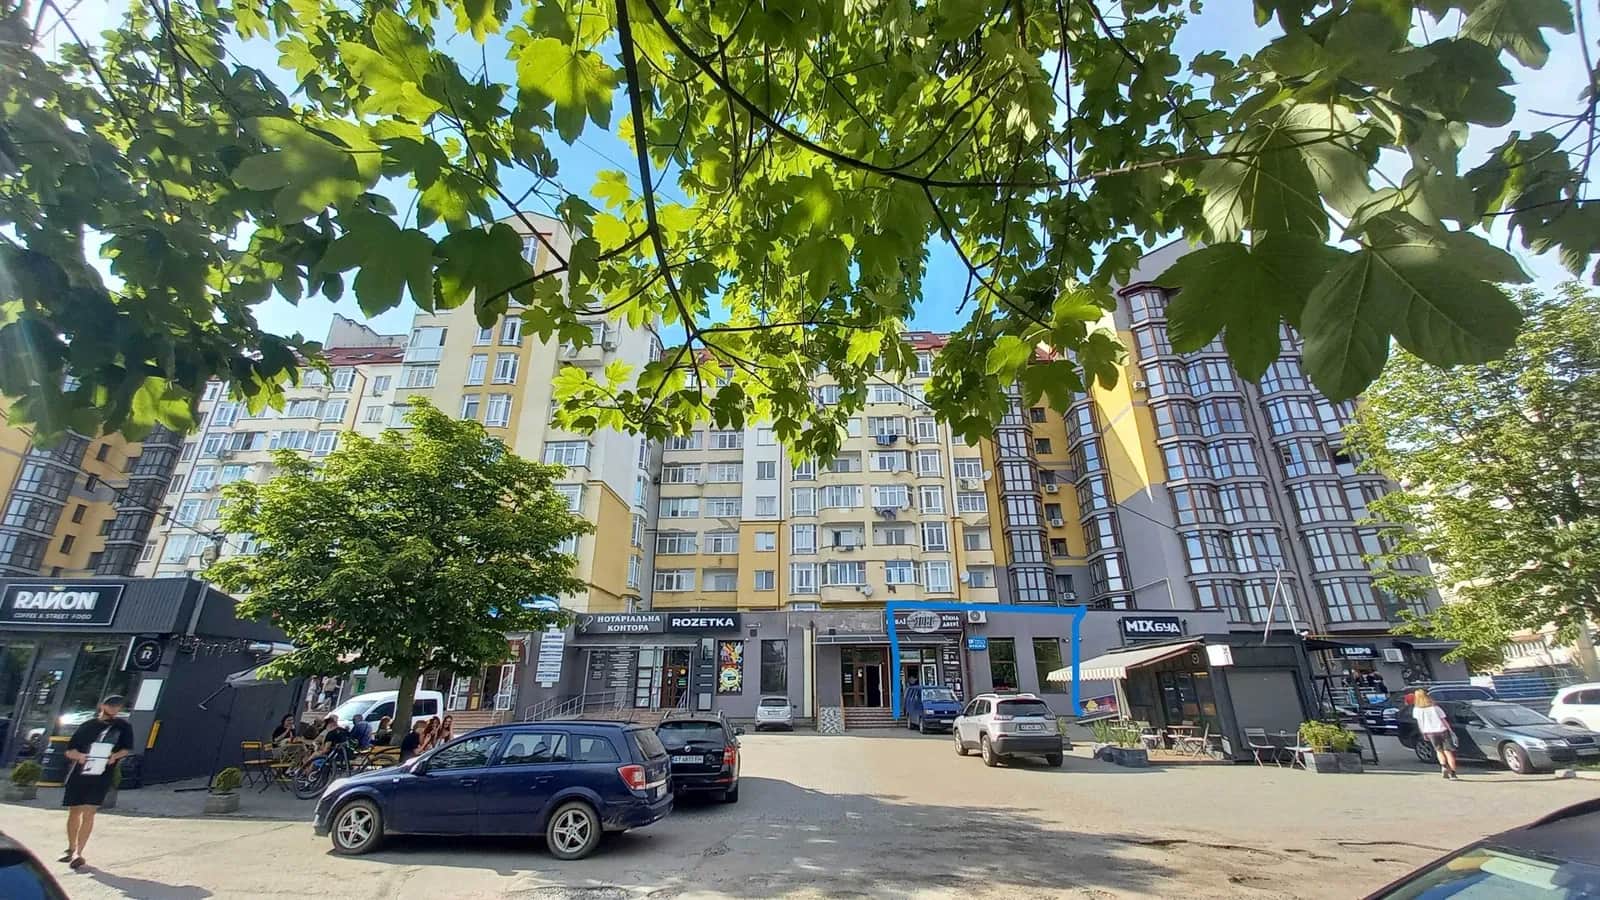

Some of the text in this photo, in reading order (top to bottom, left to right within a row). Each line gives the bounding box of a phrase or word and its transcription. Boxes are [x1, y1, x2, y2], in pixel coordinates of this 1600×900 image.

[597, 615, 661, 623] НОТАРІАЛЬНА
[671, 617, 735, 627] ROZETKA
[607, 624, 649, 632] КОНТОРА
